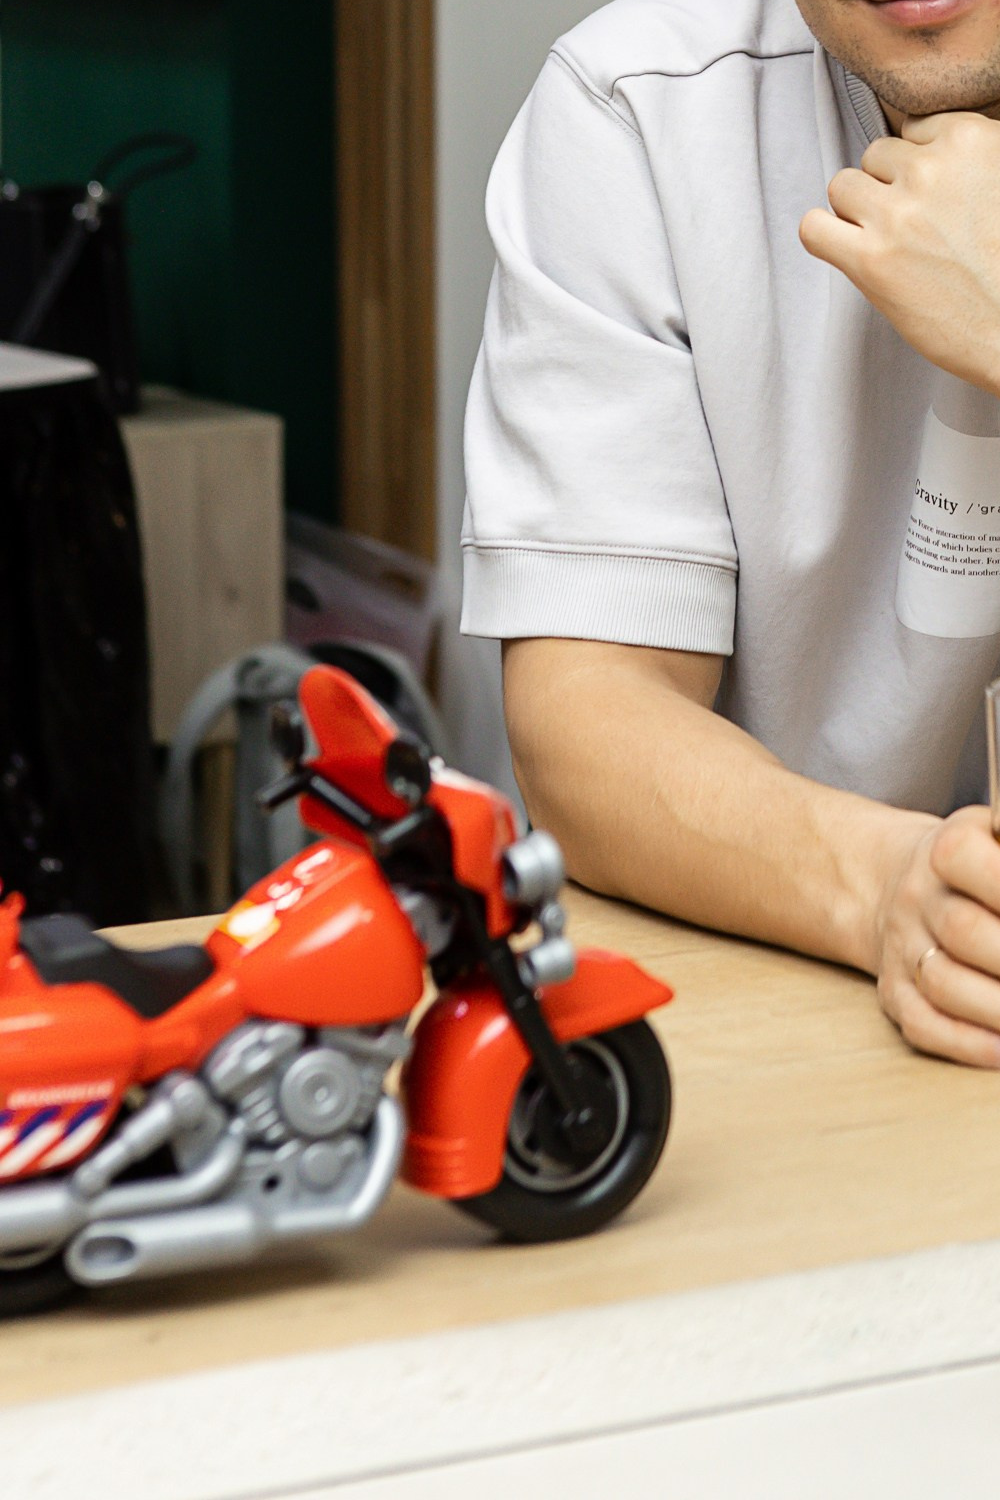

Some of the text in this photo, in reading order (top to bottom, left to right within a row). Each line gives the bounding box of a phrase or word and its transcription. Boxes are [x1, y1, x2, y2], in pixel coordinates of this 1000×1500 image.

[915, 478, 959, 515] Gravity
[918, 519, 934, 533] Force
[935, 526, 976, 541] interaction
[915, 532, 931, 544] result
[941, 542, 964, 552] which
[966, 544, 993, 553] bodies
[921, 560, 949, 573] towards
[950, 568, 966, 576] and
[939, 555, 958, 563] each
